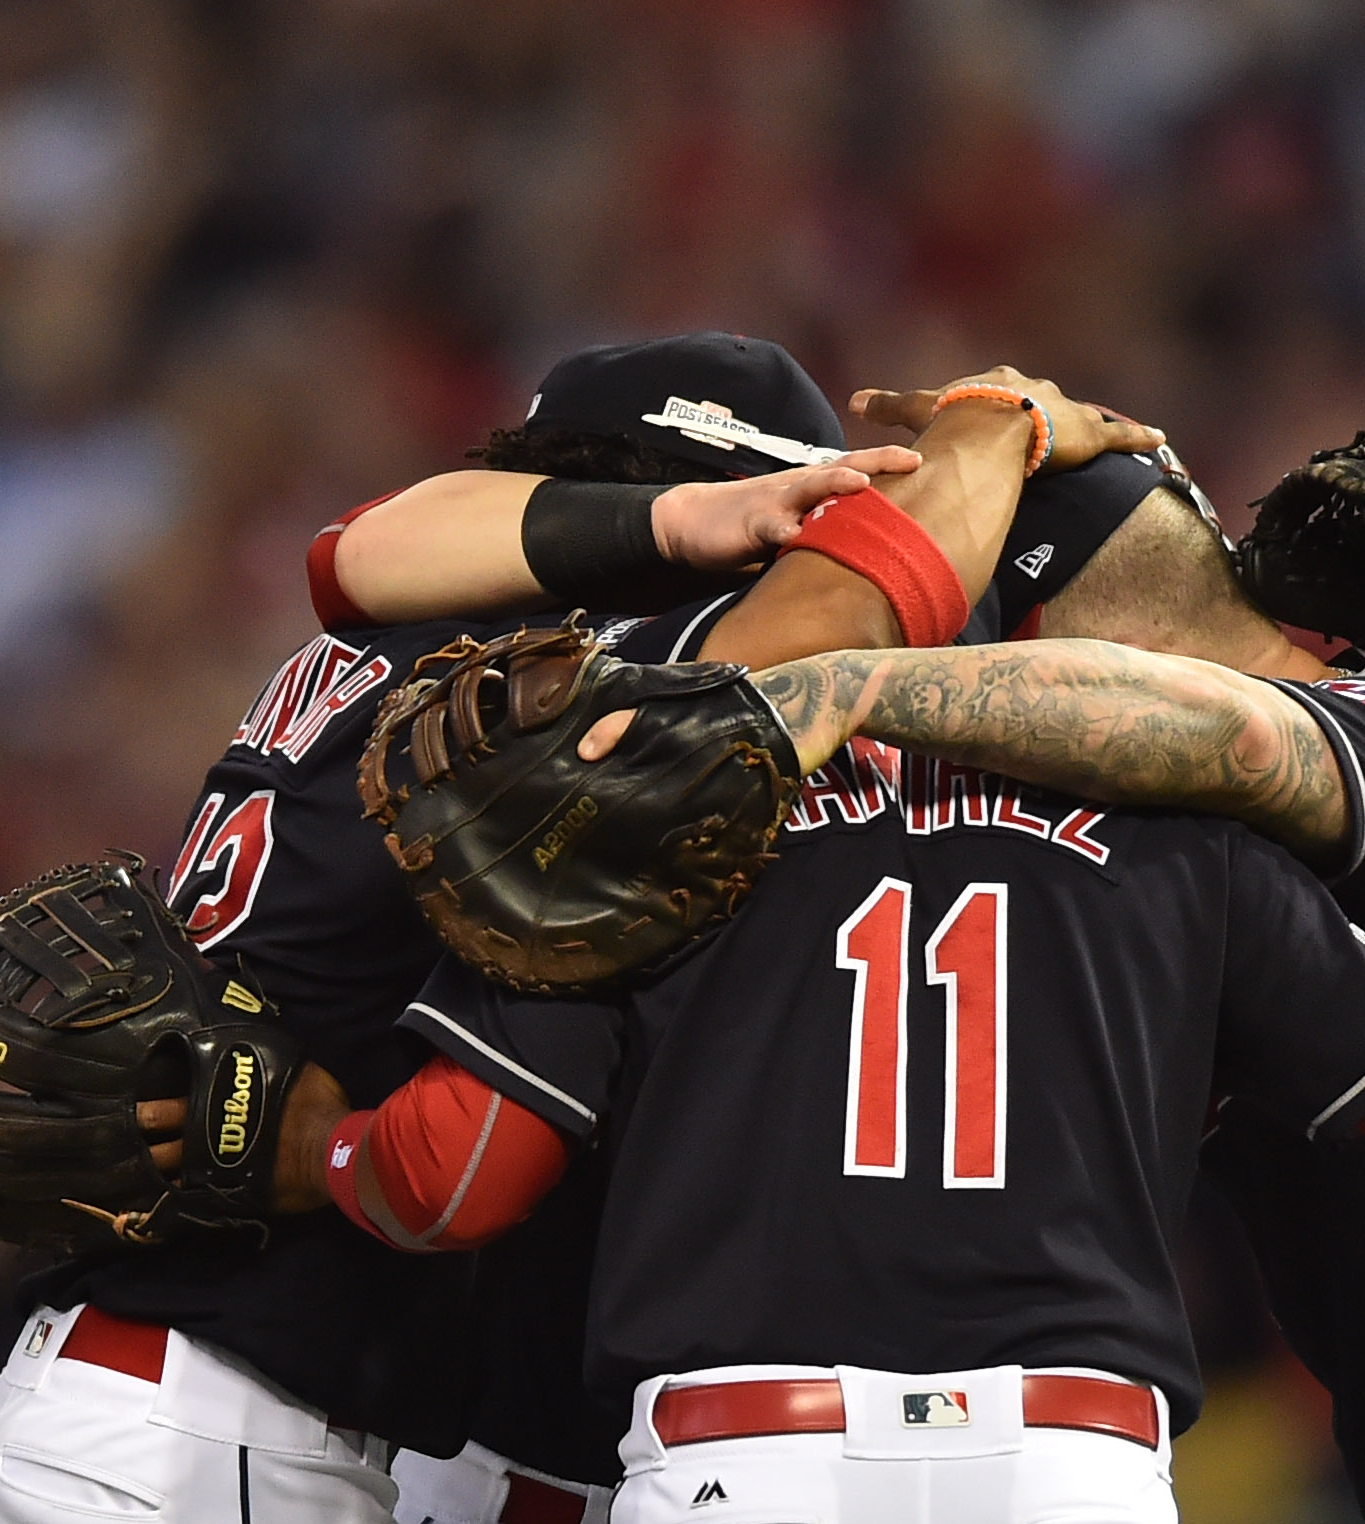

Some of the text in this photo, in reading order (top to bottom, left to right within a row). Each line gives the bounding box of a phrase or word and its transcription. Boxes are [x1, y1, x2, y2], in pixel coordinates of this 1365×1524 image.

[533, 795, 598, 872] A2000
[784, 735, 1111, 866] AMIREZ
[835, 876, 1009, 1190] 11
[218, 1051, 254, 1155] Wilson
